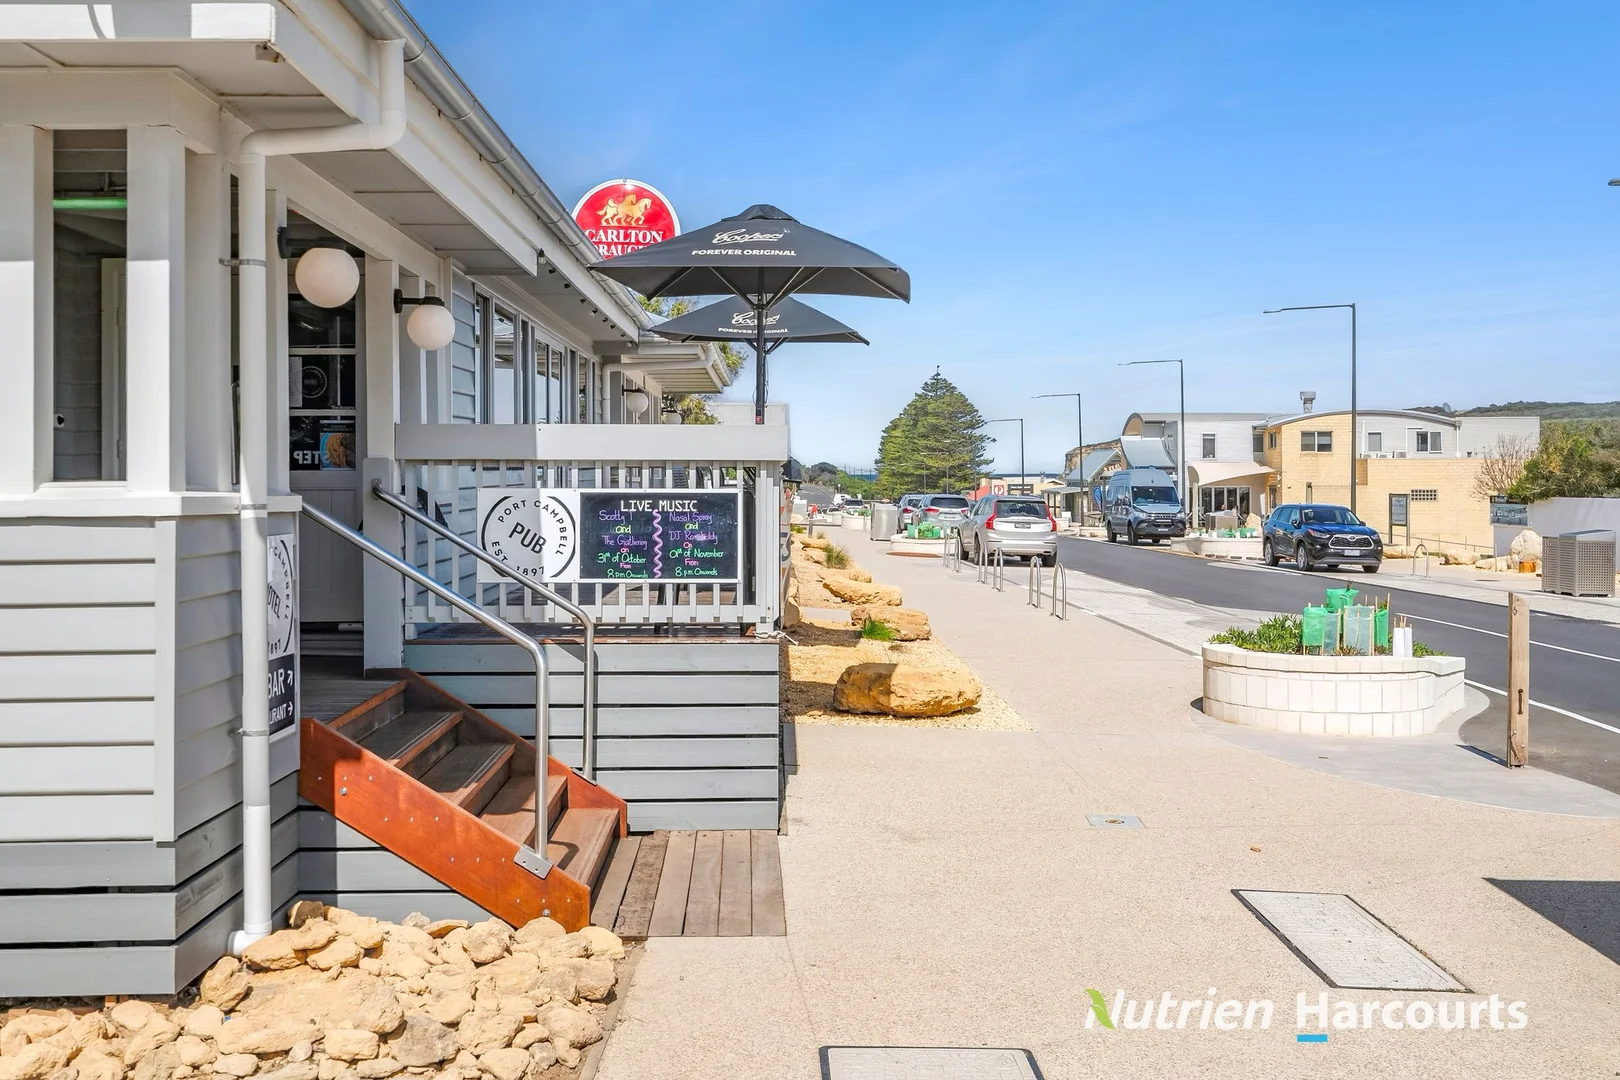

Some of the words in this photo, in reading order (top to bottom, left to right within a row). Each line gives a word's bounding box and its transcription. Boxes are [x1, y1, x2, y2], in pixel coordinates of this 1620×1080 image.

[585, 229, 664, 244] CARLTON
[621, 500, 653, 512] LIVE
[659, 500, 697, 512] MUSIC
[599, 509, 625, 525] Scotty
[669, 511, 690, 522] Nasal
[692, 512, 713, 525] Spray
[497, 500, 527, 523] PORT
[534, 500, 568, 556] CAMPBELL
[669, 531, 681, 540] DJ
[508, 521, 547, 555] PUB
[602, 535, 615, 546] The
[617, 535, 648, 550] Gathering
[491, 541, 509, 562] EST
[612, 552, 621, 563] of
[621, 552, 647, 564] October
[683, 548, 691, 558] of
[693, 548, 724, 558] November
[268, 668, 285, 699] BAR
